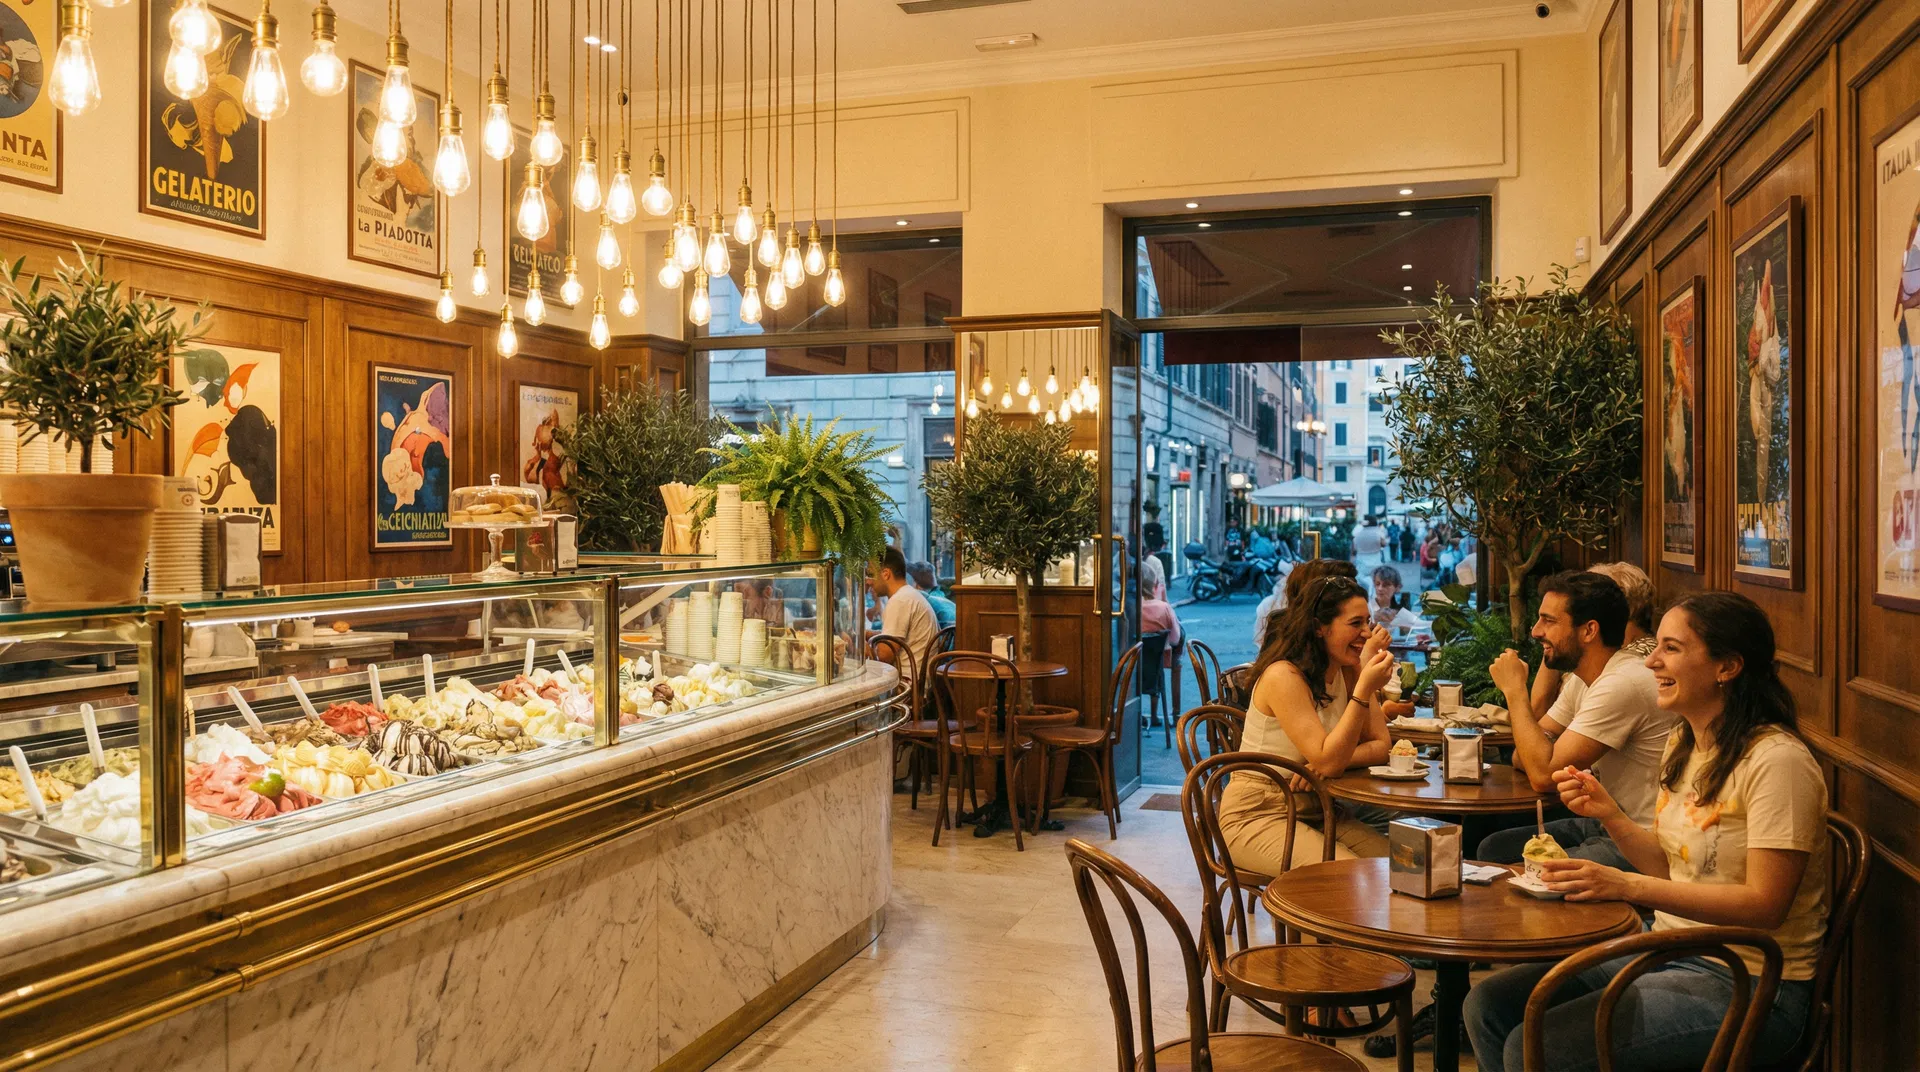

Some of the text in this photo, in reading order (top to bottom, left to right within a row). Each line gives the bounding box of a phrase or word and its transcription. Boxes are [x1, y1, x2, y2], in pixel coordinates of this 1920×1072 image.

[1882, 146, 1912, 185] ITALIA
[153, 166, 256, 216] GELATERIO
[375, 220, 433, 249] PIADOTTA
